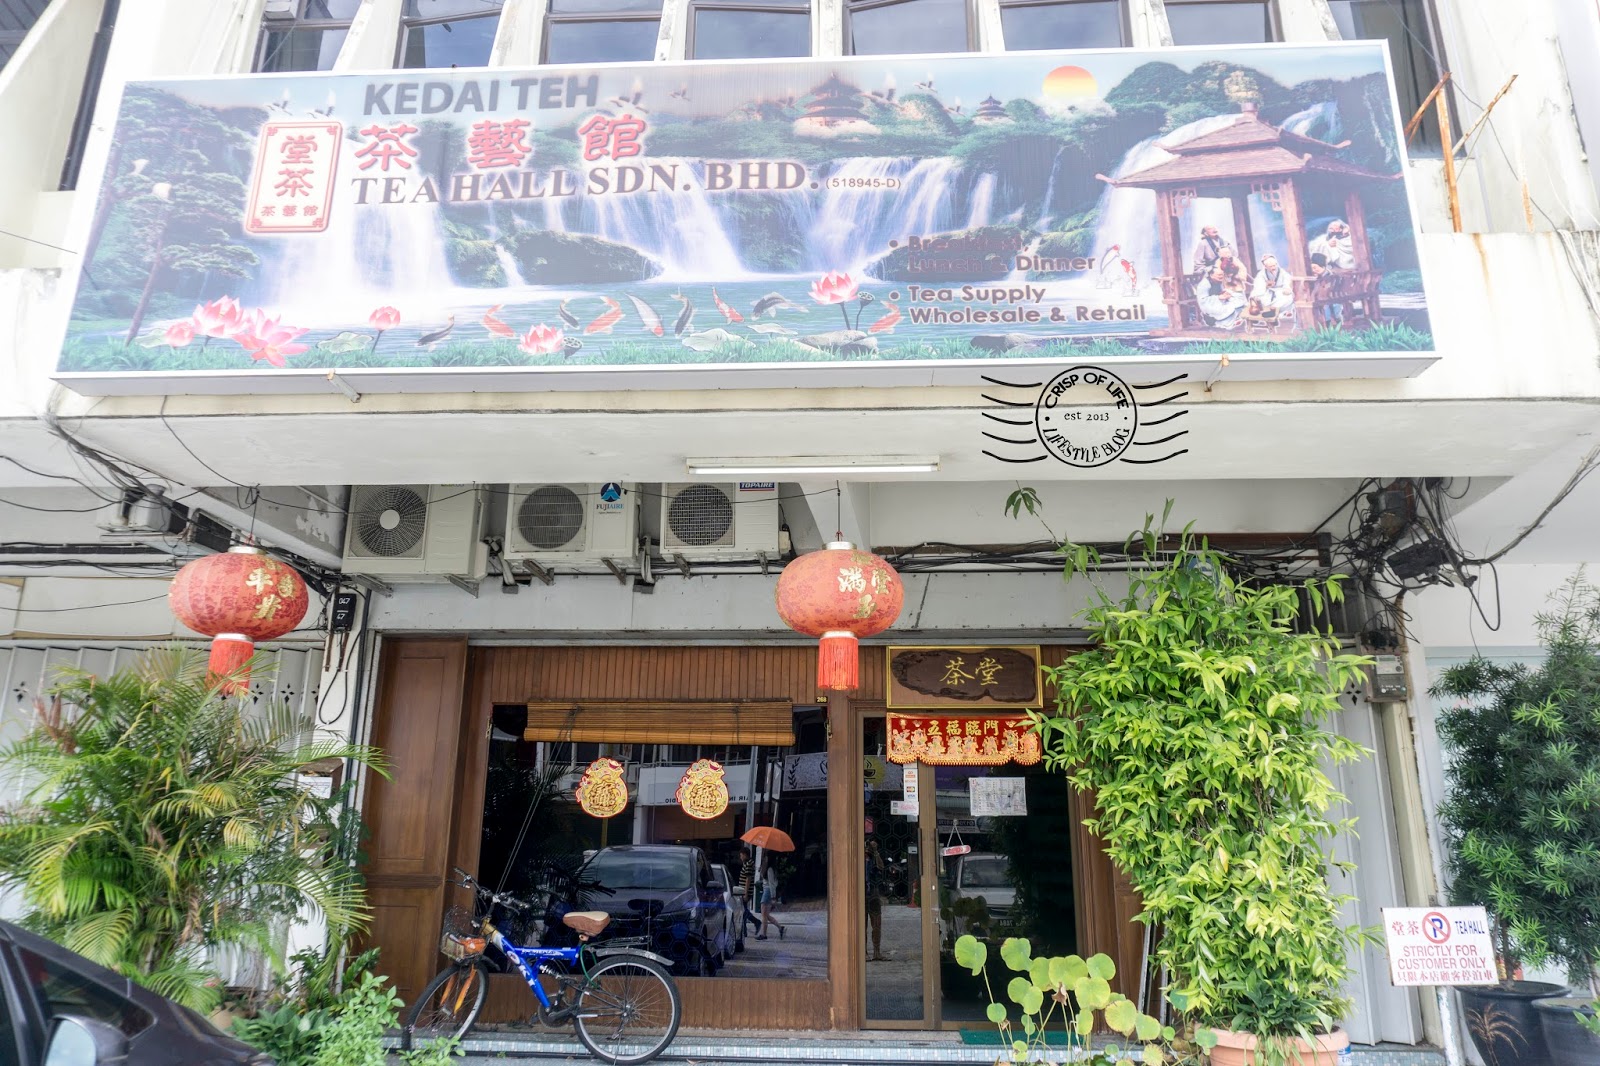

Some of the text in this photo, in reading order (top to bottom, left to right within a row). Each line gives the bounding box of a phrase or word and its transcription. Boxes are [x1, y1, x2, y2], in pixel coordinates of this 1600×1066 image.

[363, 75, 599, 117] KEDAI TEH
[351, 161, 901, 205] TEA HALL SDN. BHD. (518945-D)
[909, 254, 982, 272] Lunch
[1015, 254, 1096, 272] Dinner
[909, 284, 1047, 305] Tea Supply
[909, 304, 1146, 324] Wholesale & Retail
[596, 503, 624, 511] FUJIAIRE
[927, 719, 999, 736] 五福臨門
[1455, 920, 1485, 935] TEA HALL
[1403, 945, 1478, 957] STRICTLY FOR
[1397, 957, 1487, 970] CUSTOMER ONLY
